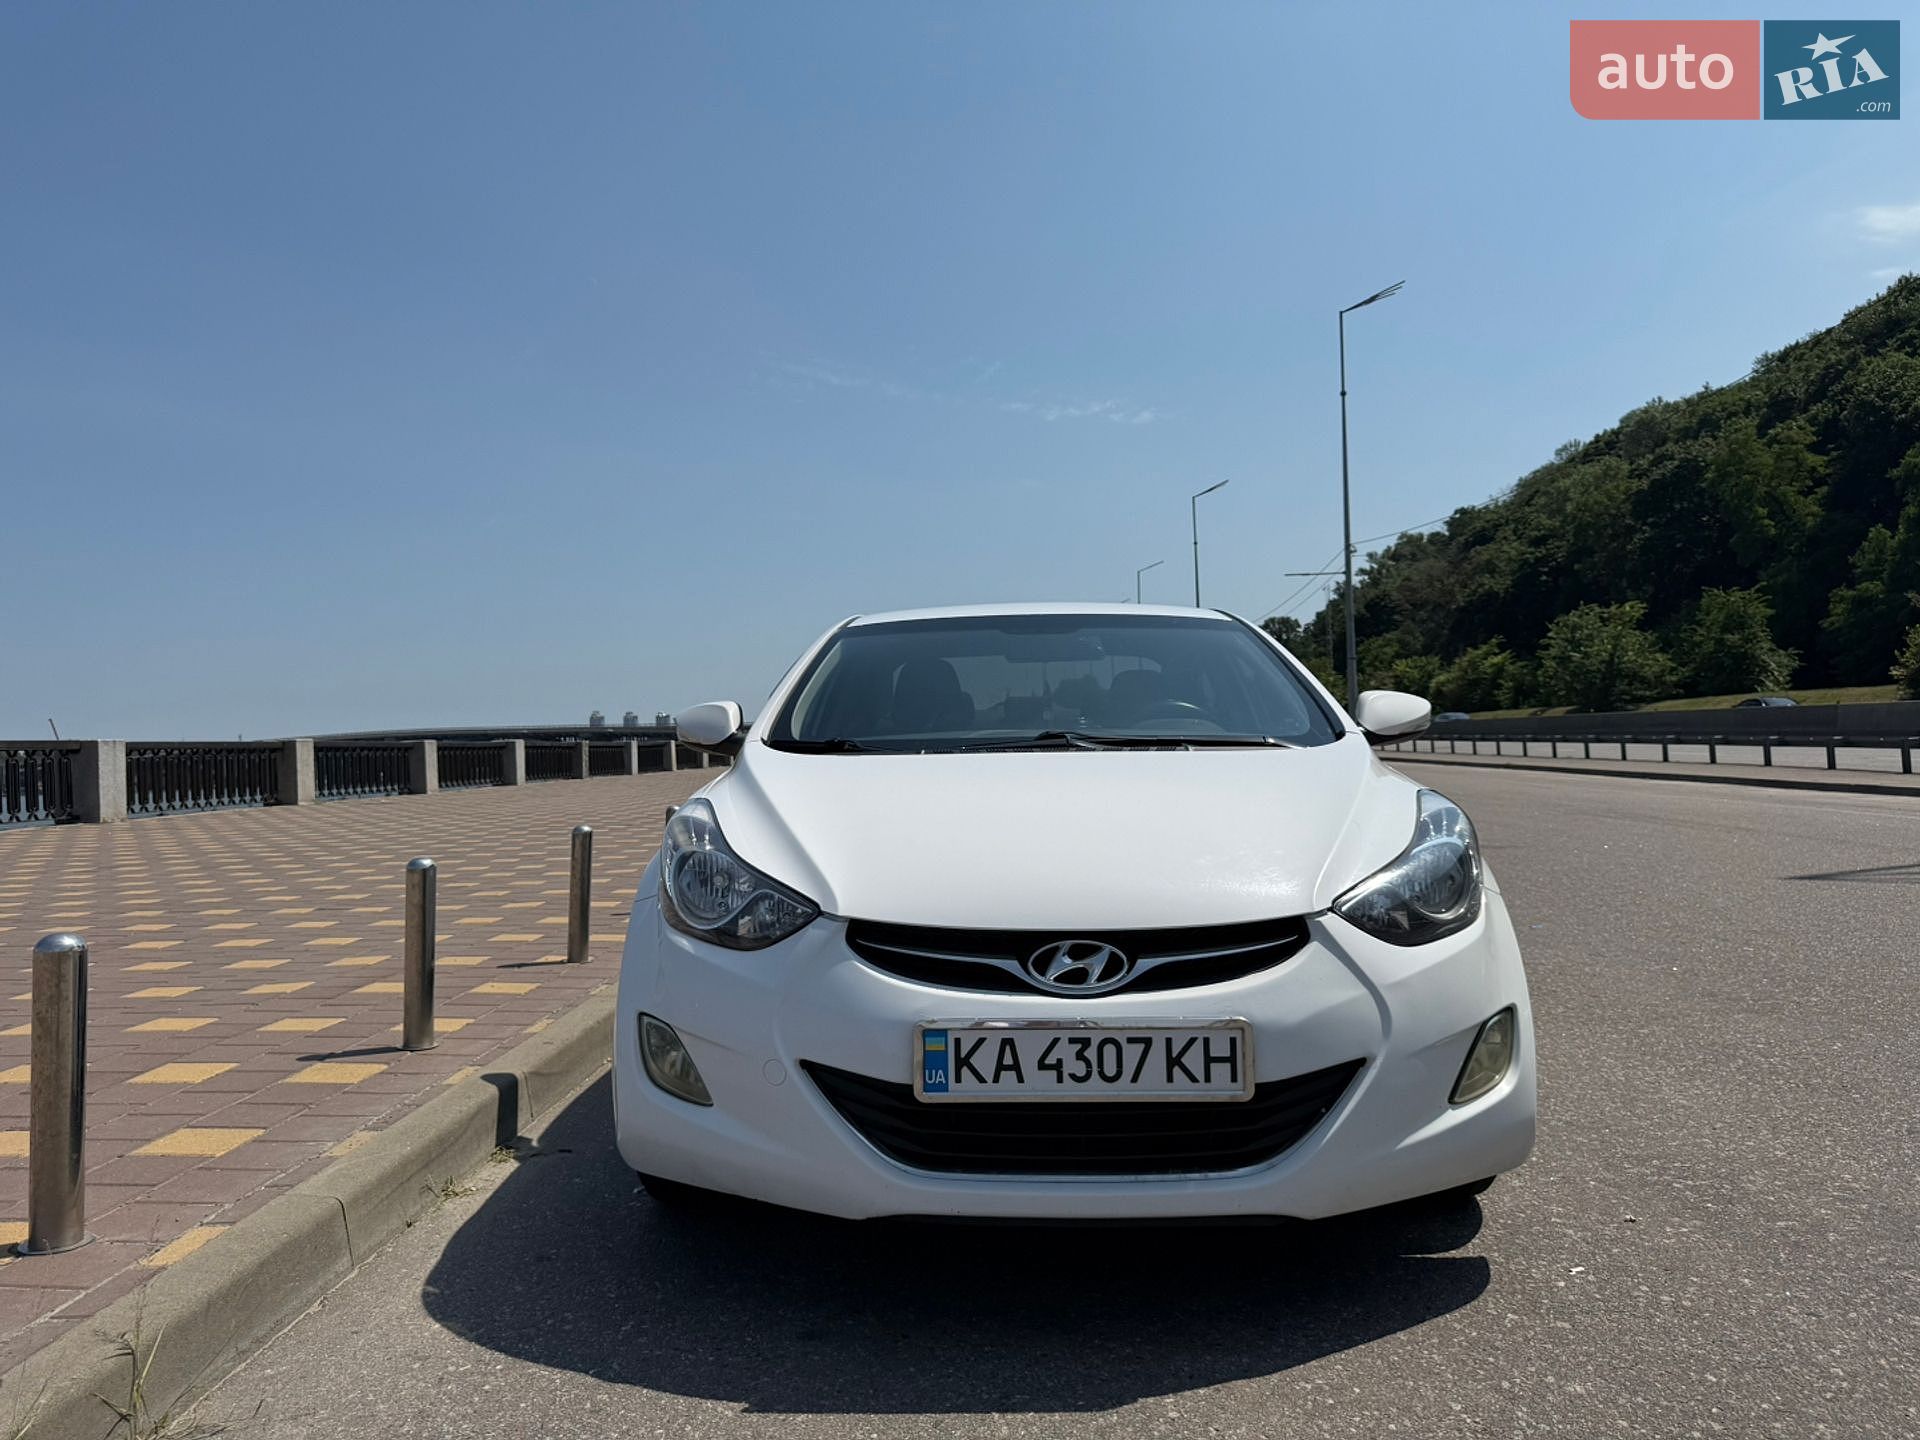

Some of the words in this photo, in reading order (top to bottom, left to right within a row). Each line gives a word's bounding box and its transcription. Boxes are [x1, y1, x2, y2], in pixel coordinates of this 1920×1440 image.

[954, 1037, 1024, 1083] KA
[1037, 1037, 1153, 1084] 4307
[1165, 1037, 1238, 1083] KH
[925, 1069, 946, 1084] UA
